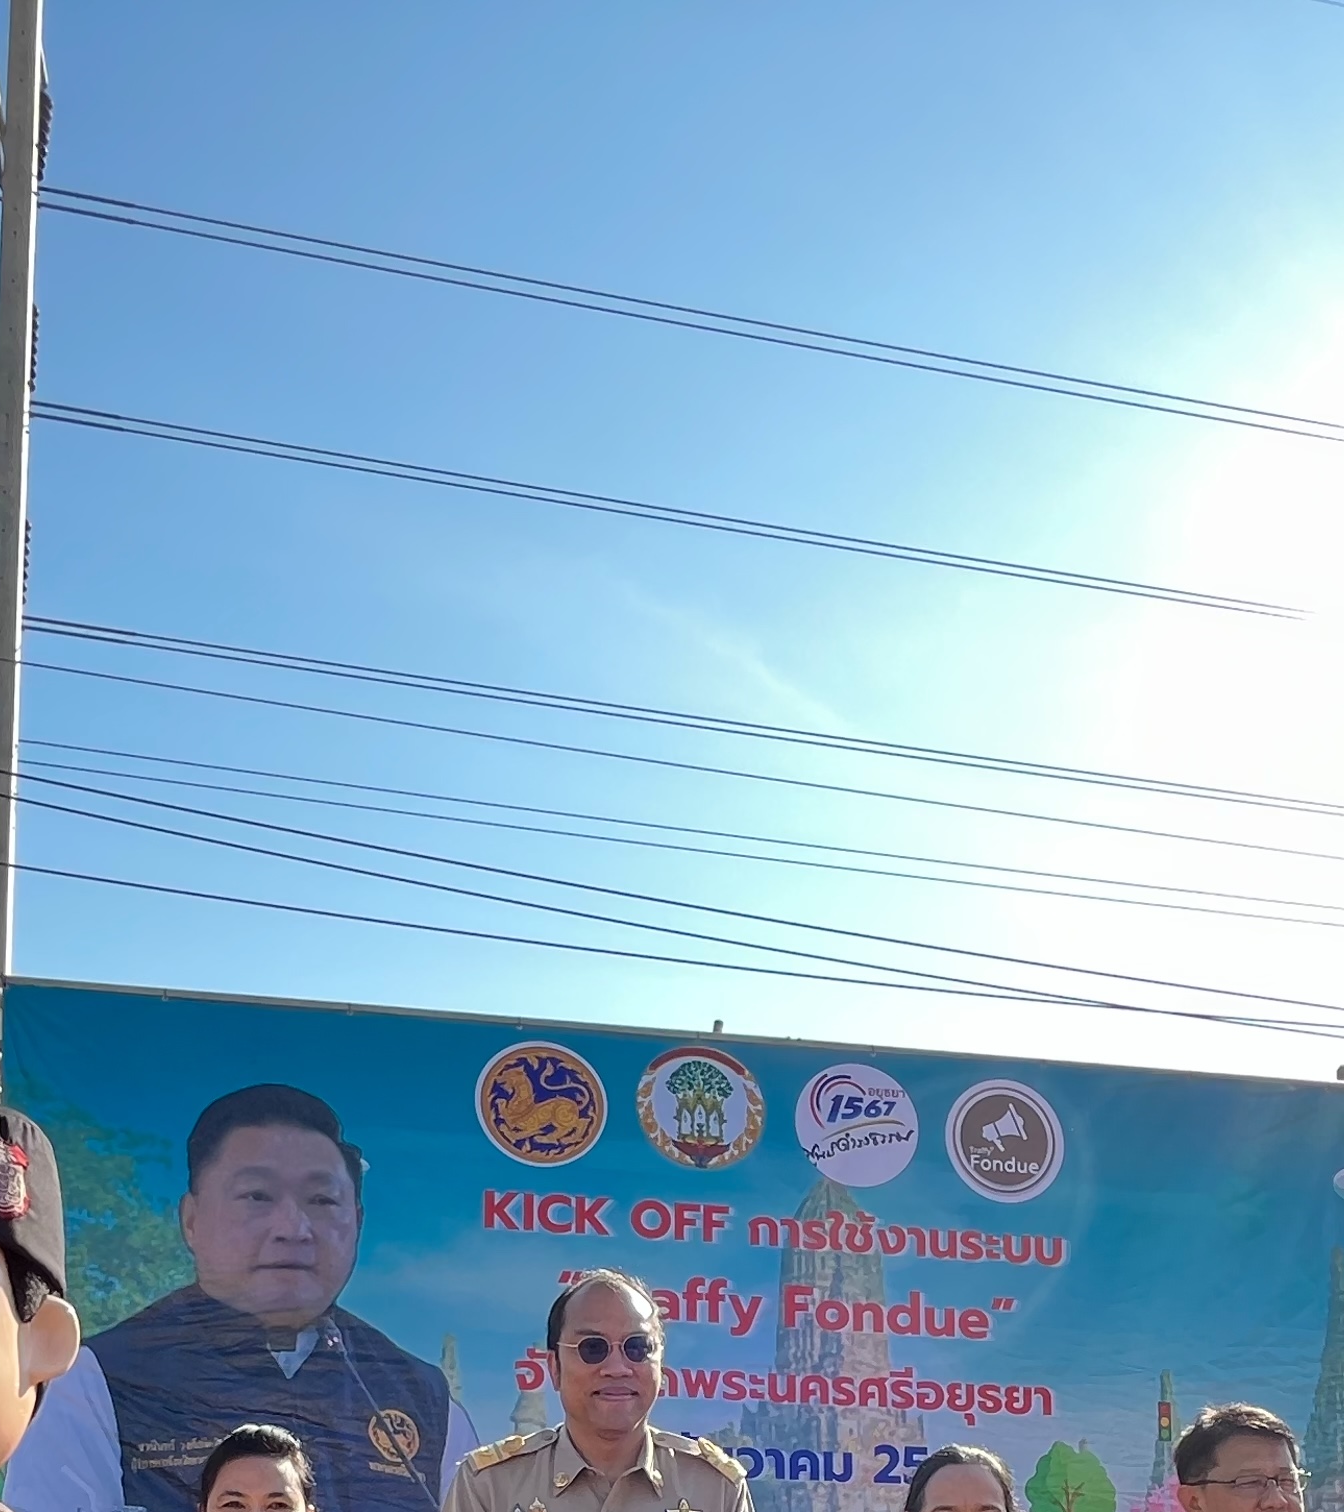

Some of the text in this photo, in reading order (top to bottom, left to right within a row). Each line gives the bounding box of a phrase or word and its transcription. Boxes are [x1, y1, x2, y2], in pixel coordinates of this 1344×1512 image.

[826, 1095, 897, 1123] 1567
[970, 1155, 1040, 1174] Fondue
[484, 1190, 1064, 1266] KICK OFF การใช้งานระบบ
